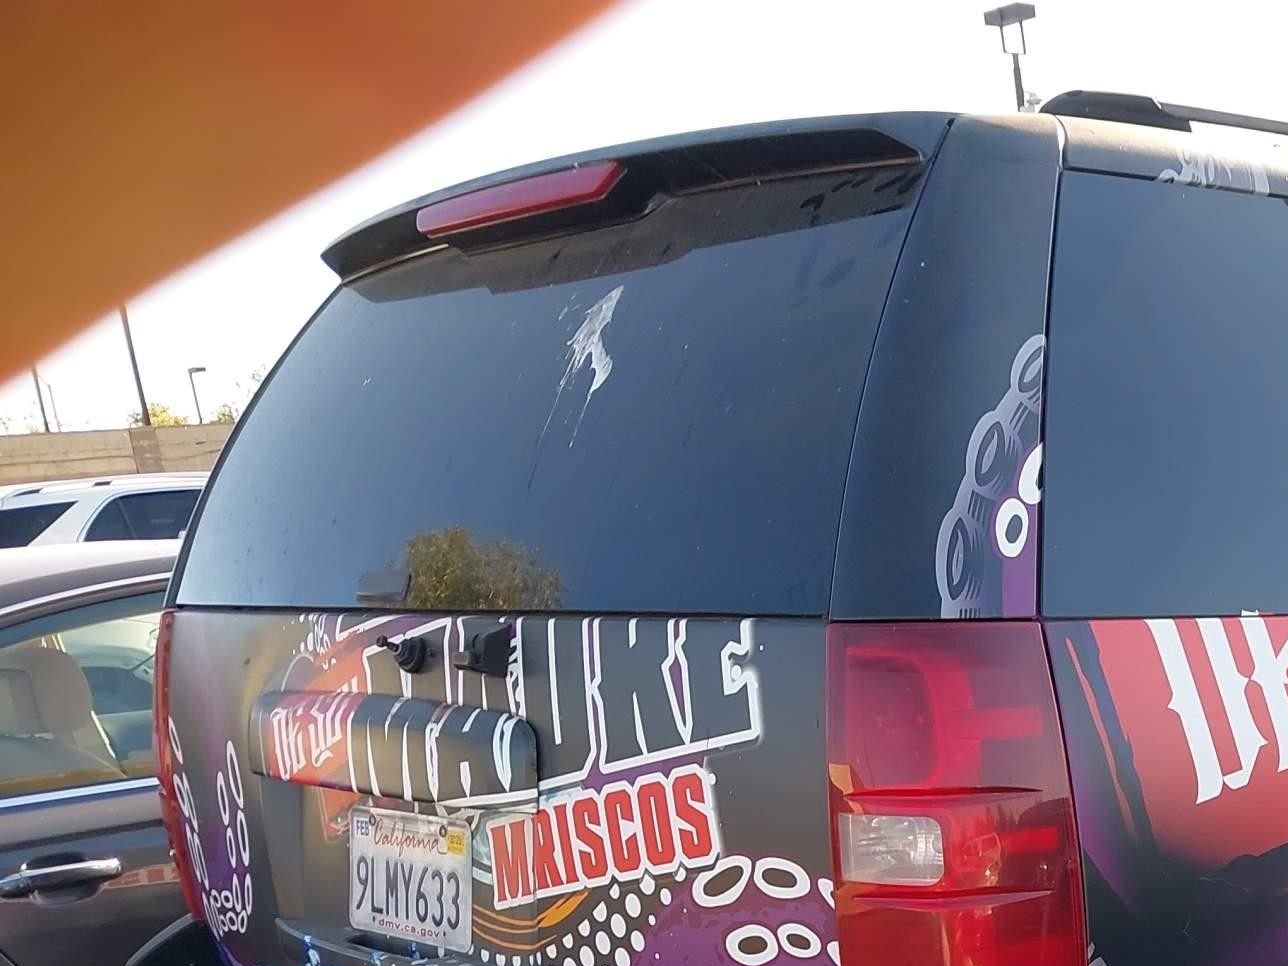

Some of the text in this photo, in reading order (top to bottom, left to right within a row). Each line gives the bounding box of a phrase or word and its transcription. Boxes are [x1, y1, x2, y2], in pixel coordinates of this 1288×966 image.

[356, 819, 370, 837] FEB
[373, 817, 448, 858] California
[356, 855, 460, 930] 9LMY633
[378, 917, 440, 938] dmv.ca.gov
